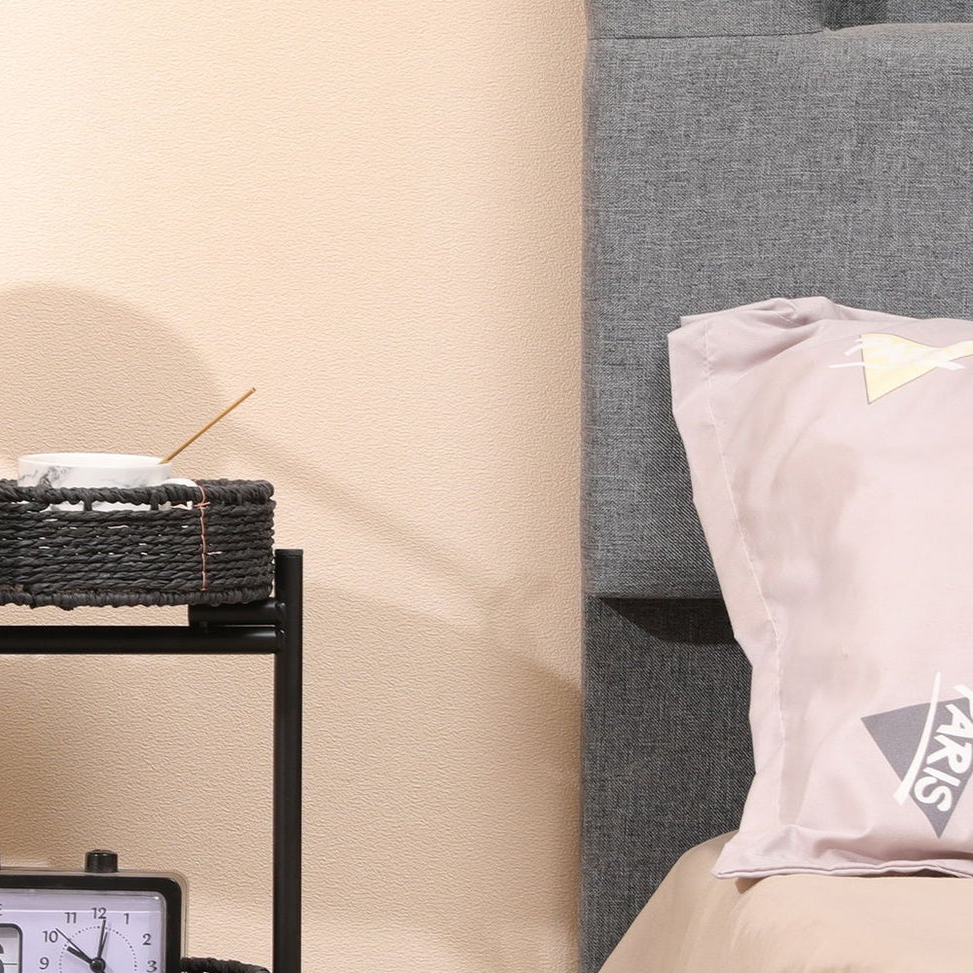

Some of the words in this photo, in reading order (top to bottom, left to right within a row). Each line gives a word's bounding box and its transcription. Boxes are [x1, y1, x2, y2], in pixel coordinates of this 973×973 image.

[64, 912, 77, 924] 11
[91, 907, 107, 919] 12
[123, 913, 130, 925] 1
[42, 930, 59, 943] 10
[142, 933, 152, 945] 2
[39, 956, 50, 970] 9
[146, 960, 157, 973] 3
